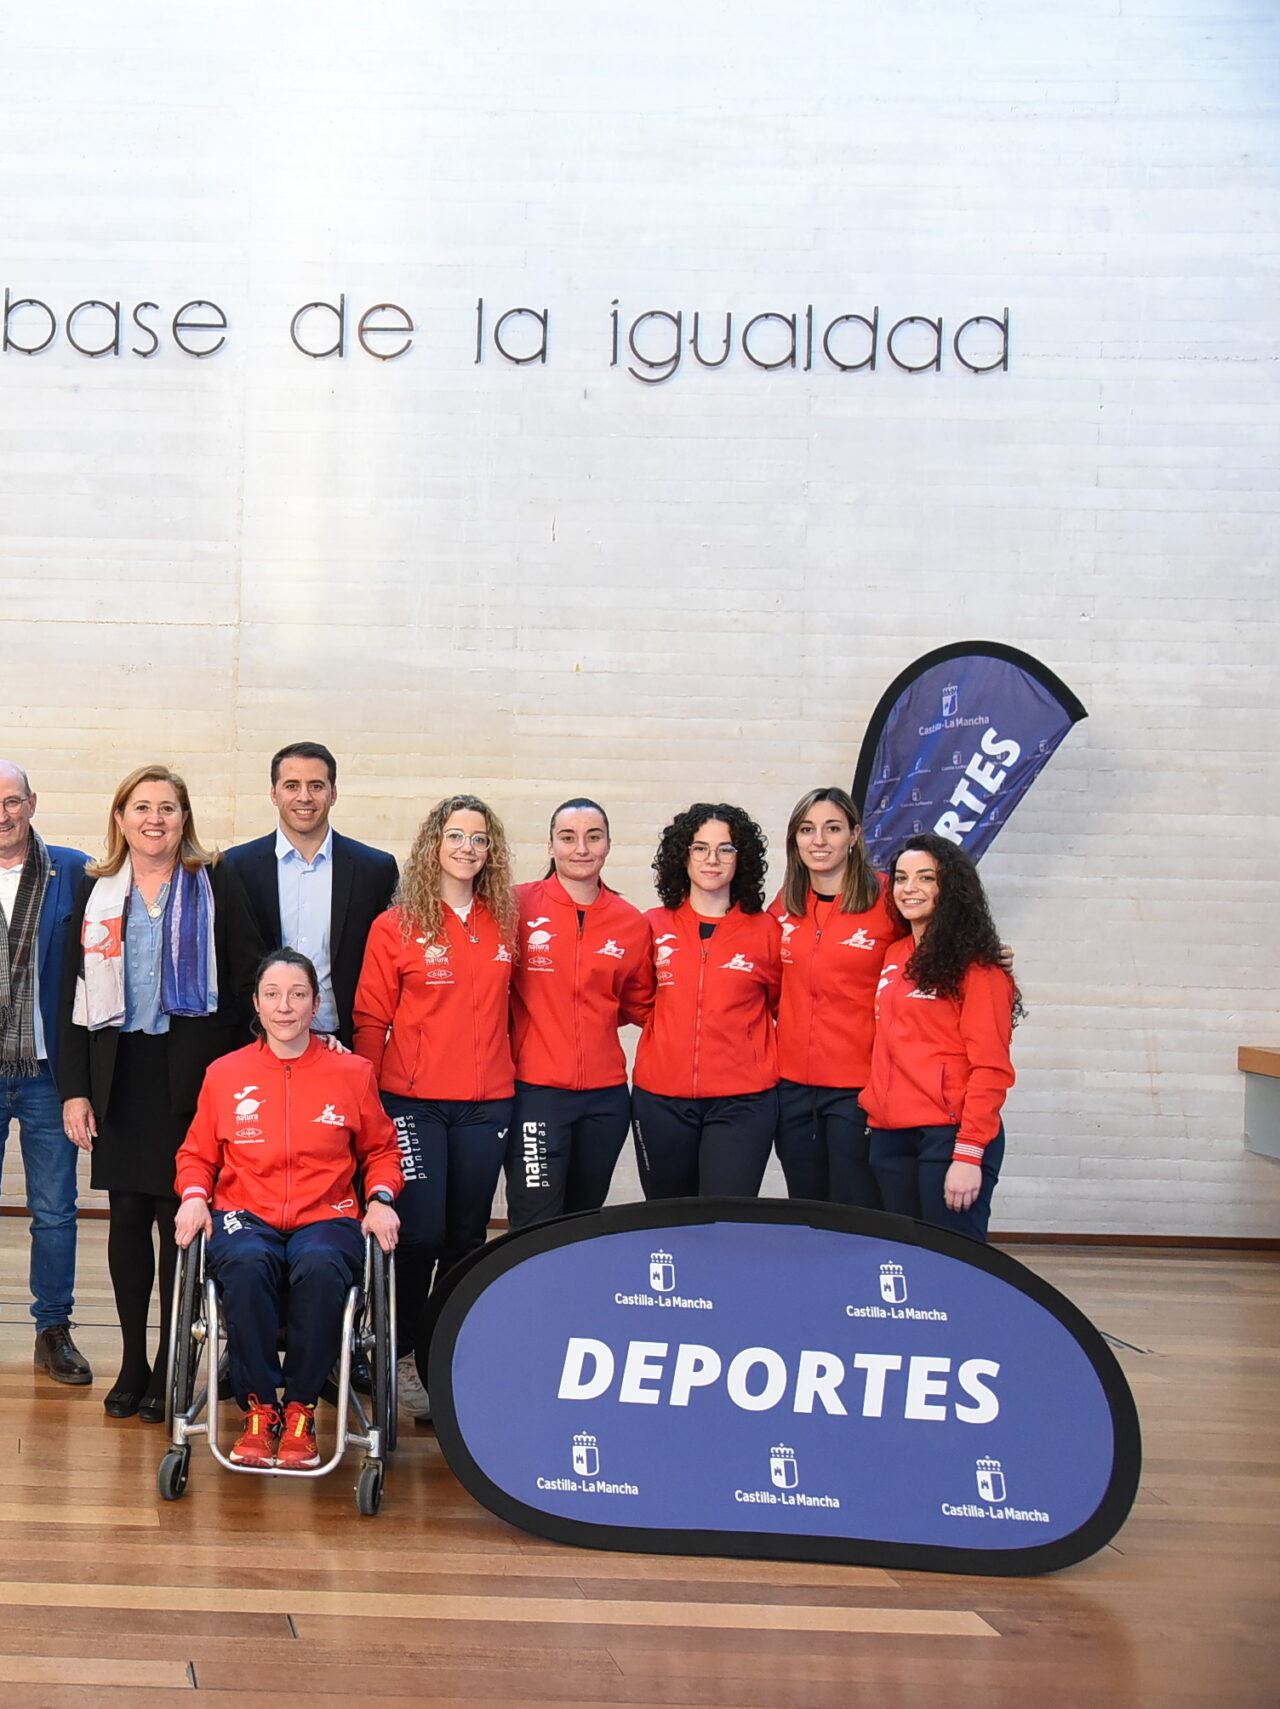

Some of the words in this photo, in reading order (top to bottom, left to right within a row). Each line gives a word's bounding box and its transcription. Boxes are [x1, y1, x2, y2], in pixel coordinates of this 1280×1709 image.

[3, 288, 227, 358] base
[293, 293, 414, 361] de
[475, 298, 548, 365] la
[610, 299, 1009, 383] igualdad
[955, 714, 990, 729] Mancha
[393, 1116, 417, 1182] natura
[406, 1115, 428, 1179] pinturas
[523, 1121, 541, 1188] natura
[538, 1121, 551, 1188] pinturas
[614, 1291, 673, 1308] Castilla-La
[673, 1296, 713, 1310] Mancha
[845, 1304, 905, 1319] Castilla-La
[905, 1308, 948, 1321] Mancha
[556, 1336, 1001, 1424] DEPORTES
[536, 1476, 596, 1492] Castilla-La
[596, 1480, 639, 1496] Mancha
[734, 1489, 796, 1505] Castilla-La
[796, 1494, 840, 1509] Mancha
[941, 1503, 1004, 1519] Castilla-La
[1004, 1508, 1050, 1523] Mancha
